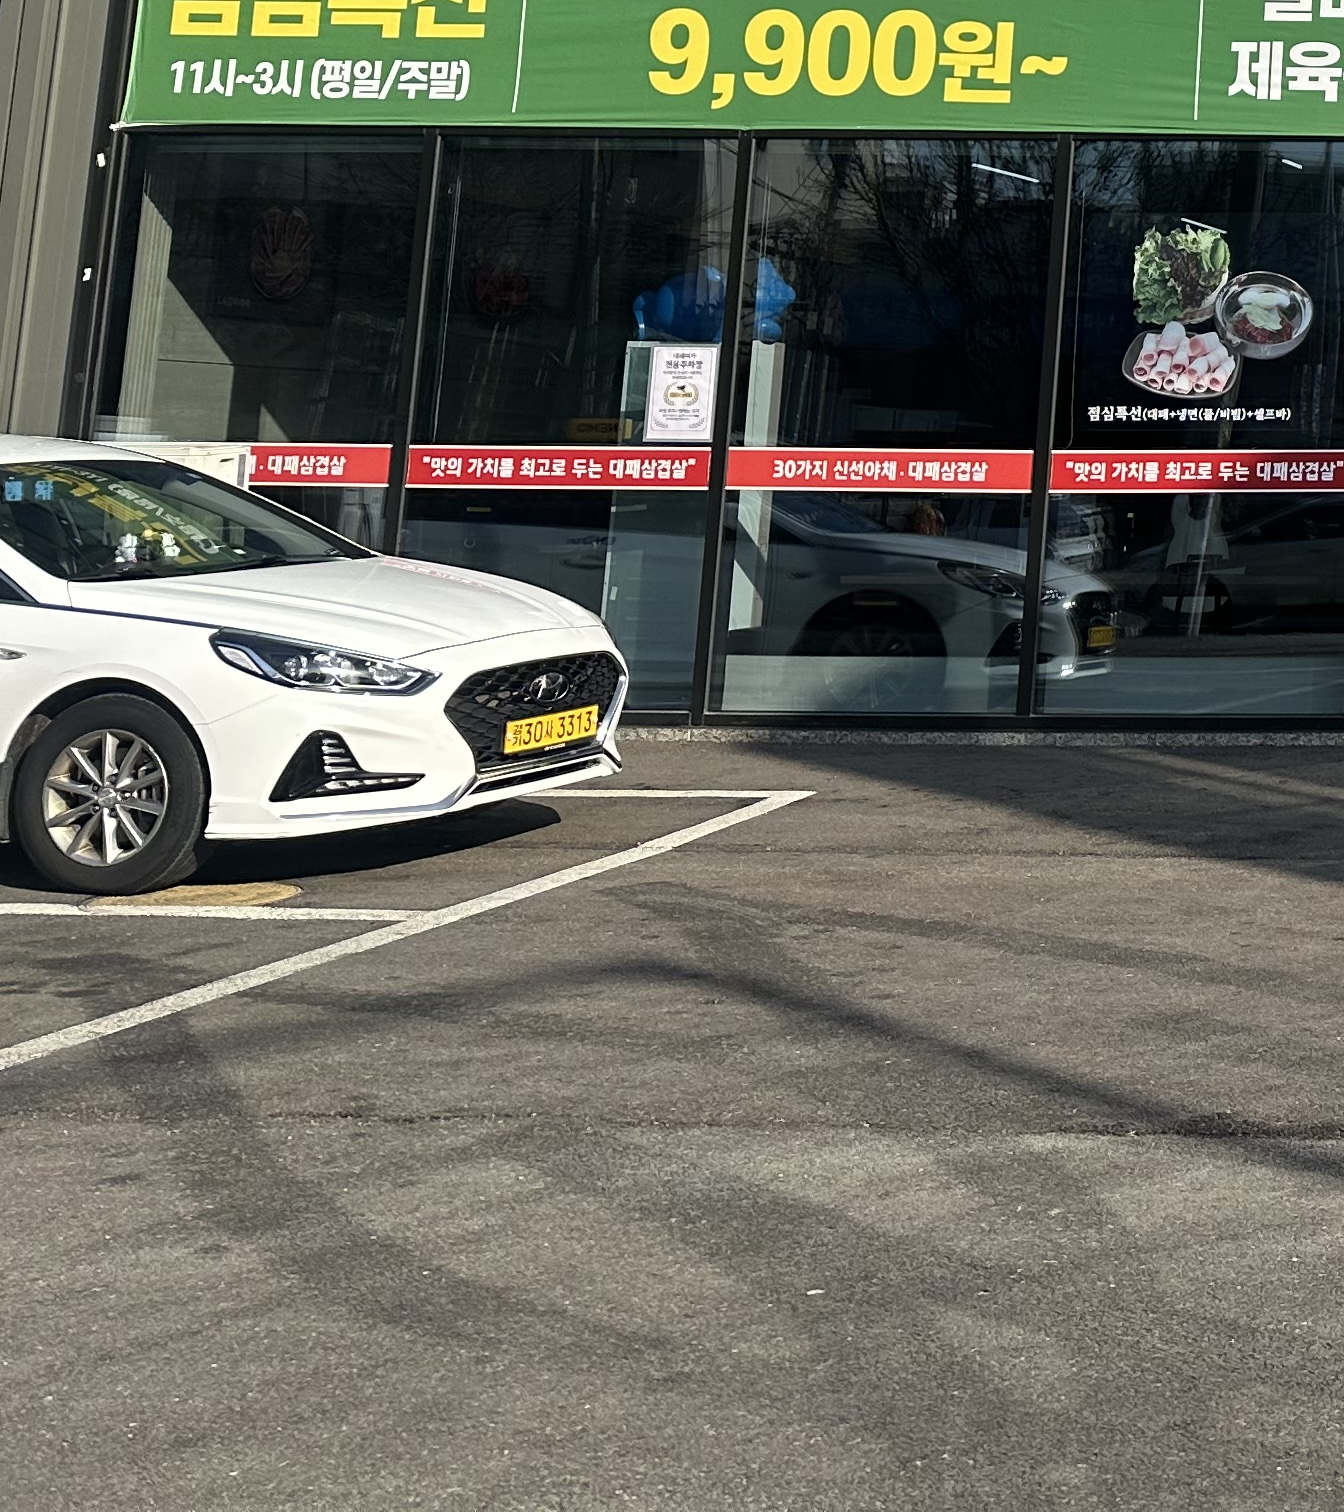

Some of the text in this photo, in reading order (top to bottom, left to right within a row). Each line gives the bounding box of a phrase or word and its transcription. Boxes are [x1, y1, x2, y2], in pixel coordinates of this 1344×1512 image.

[648, 8, 1068, 110] 9,900원~
[169, 59, 471, 102] 11시~3시 (평일/주말)
[268, 455, 346, 476] 대패삼겹살
[468, 458, 514, 479] 가치를
[520, 458, 566, 478] 최고로
[571, 458, 603, 478] 두는
[609, 458, 696, 479] 대패삼겹살"
[772, 459, 988, 482] 30가지 신선야채 대패삼겹살
[1112, 461, 1159, 482] 가치를
[1165, 461, 1213, 482] 최고로
[1218, 462, 1250, 482] 두는
[1256, 461, 1344, 482] 대패삼겹살"
[557, 710, 593, 738] 3313
